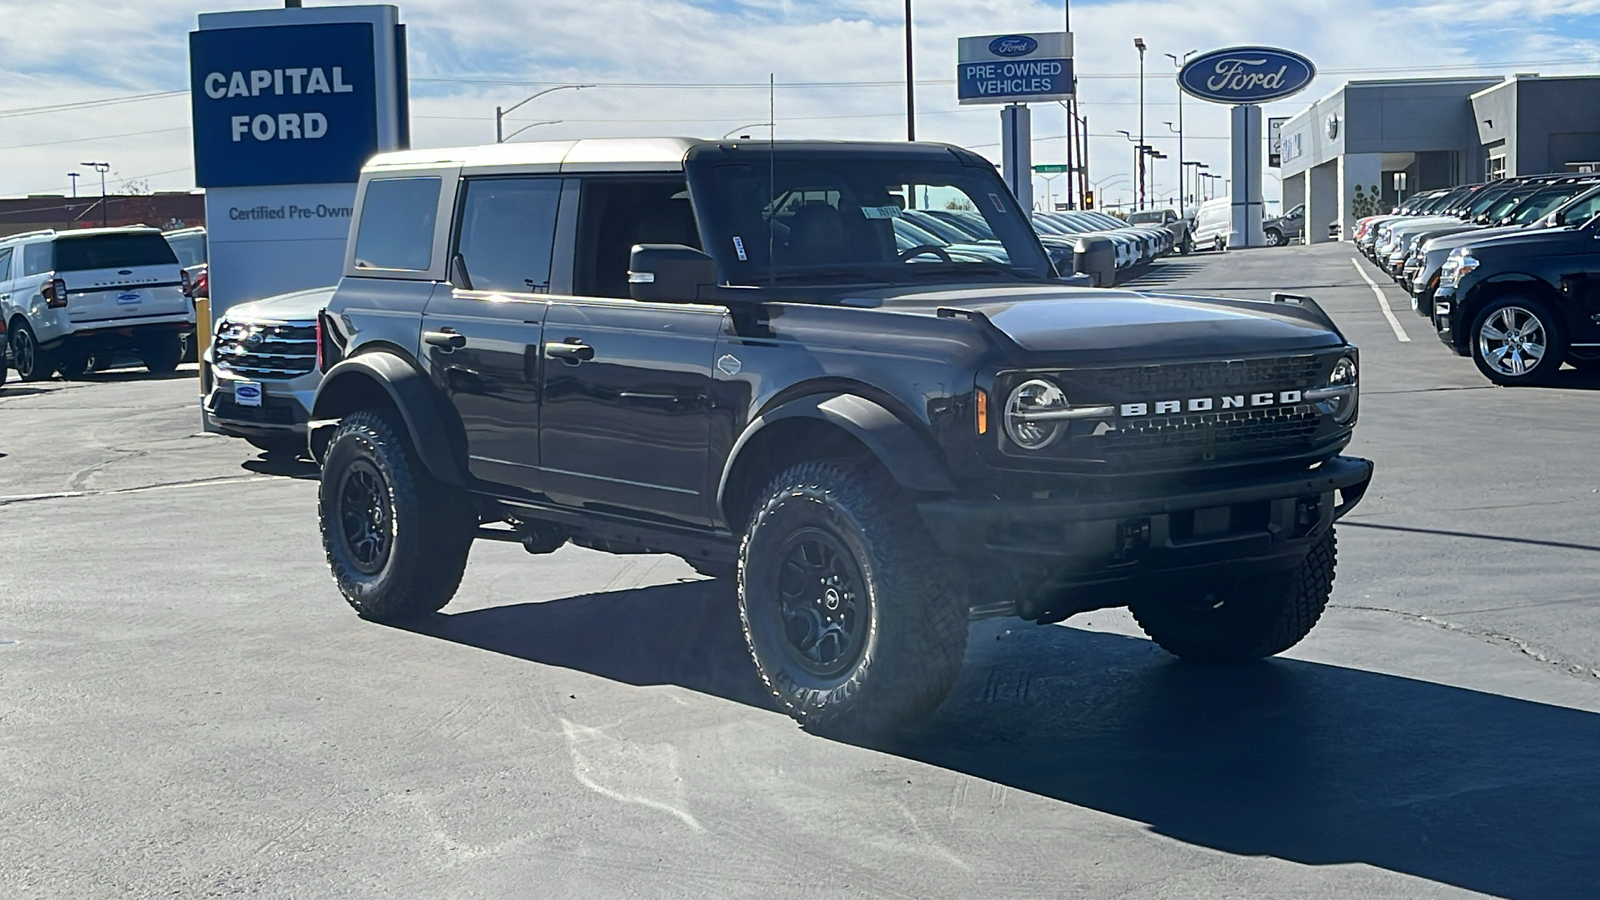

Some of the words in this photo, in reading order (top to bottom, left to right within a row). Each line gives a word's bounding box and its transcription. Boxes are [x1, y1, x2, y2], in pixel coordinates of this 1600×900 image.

[999, 39, 1028, 53] Ford
[966, 62, 1062, 80] PRE-OWNED
[1206, 58, 1288, 92] Ford
[204, 66, 353, 99] CAPITAL
[977, 78, 1052, 94] VEHICLES
[231, 112, 328, 142] FORD
[229, 206, 285, 221] Certified
[1120, 390, 1302, 417] BRONCO
